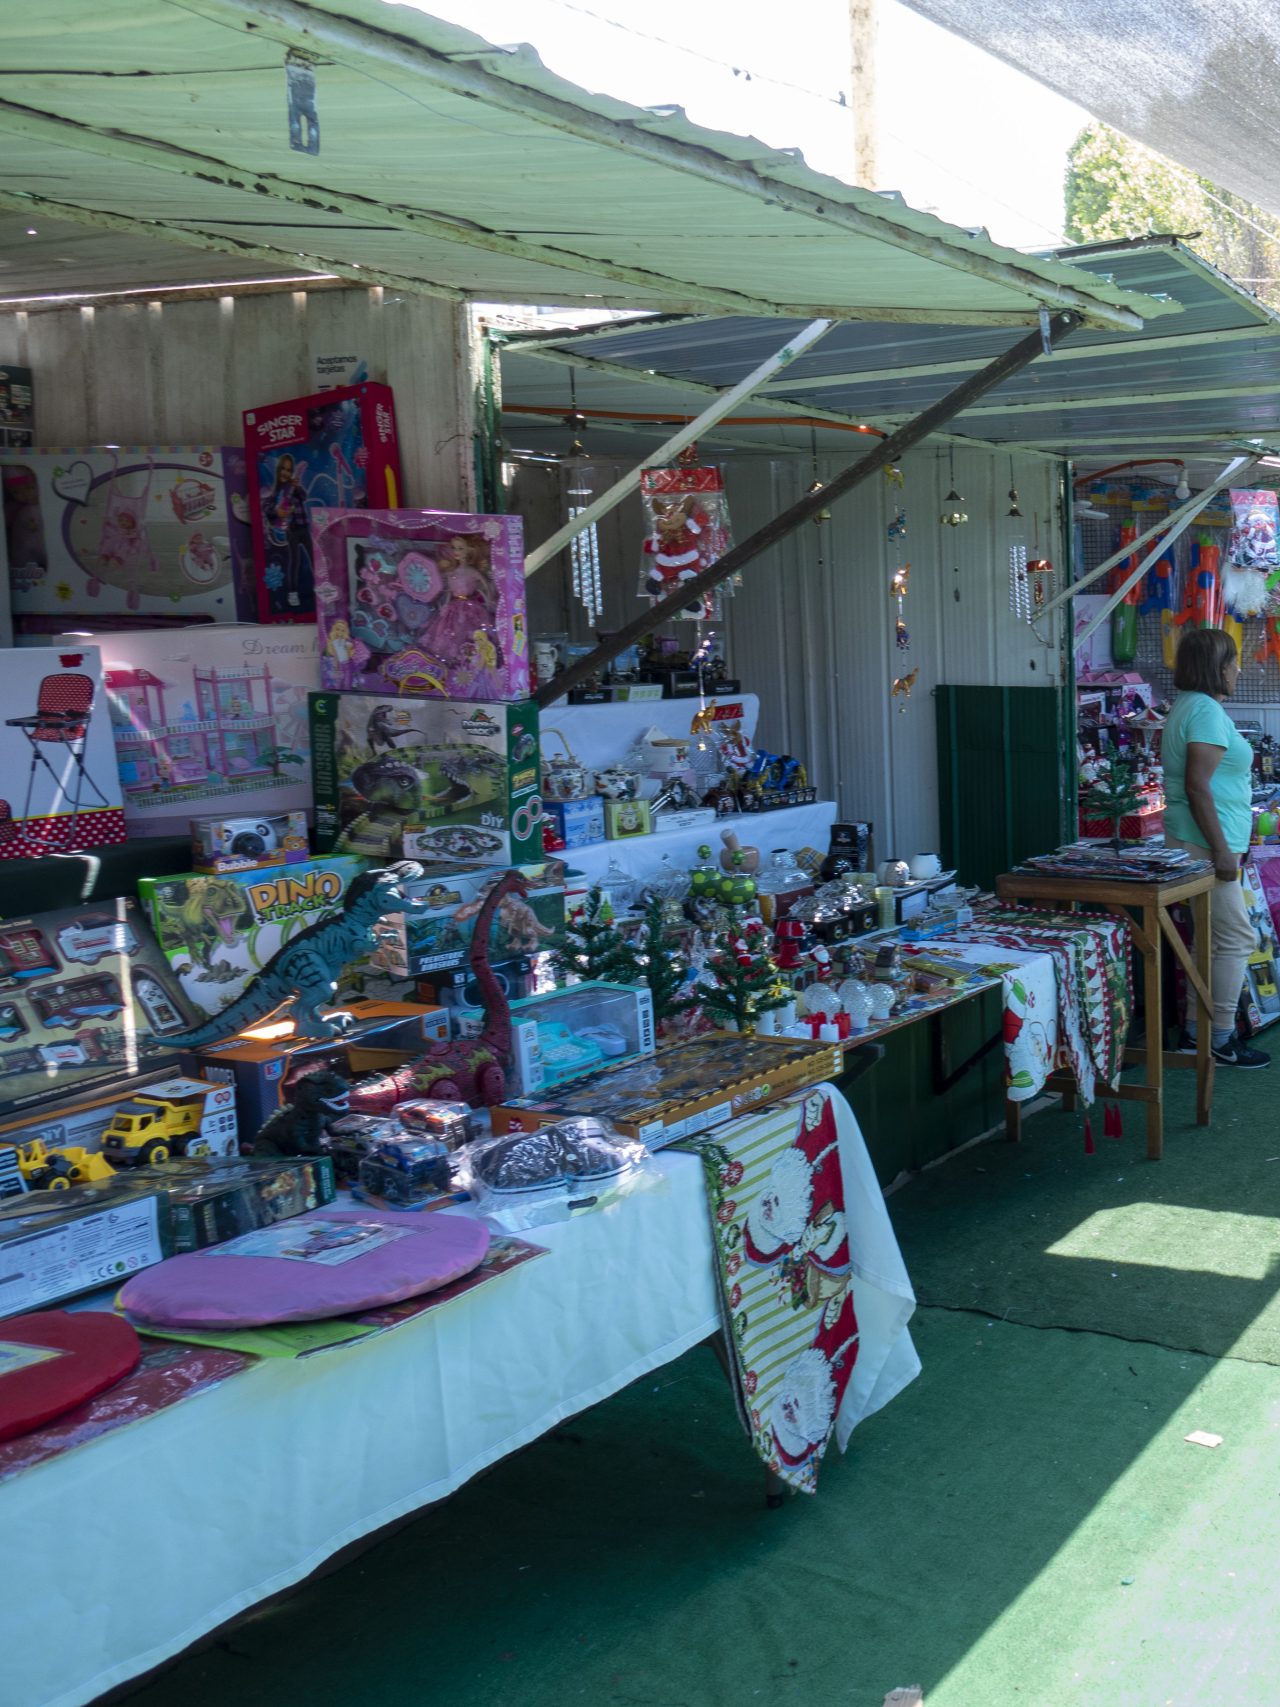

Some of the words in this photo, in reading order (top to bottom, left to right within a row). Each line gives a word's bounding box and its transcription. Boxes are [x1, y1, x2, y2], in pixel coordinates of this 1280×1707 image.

[316, 355, 358, 365] Aceptamos
[316, 365, 346, 375] tarjetas
[256, 415, 303, 436] SINGER
[269, 426, 296, 442] STAR
[241, 638, 306, 656] Dream
[481, 813, 505, 828] DIY
[217, 859, 258, 872] Bubble
[249, 871, 341, 911] DINO
[261, 893, 329, 921] TRACK
